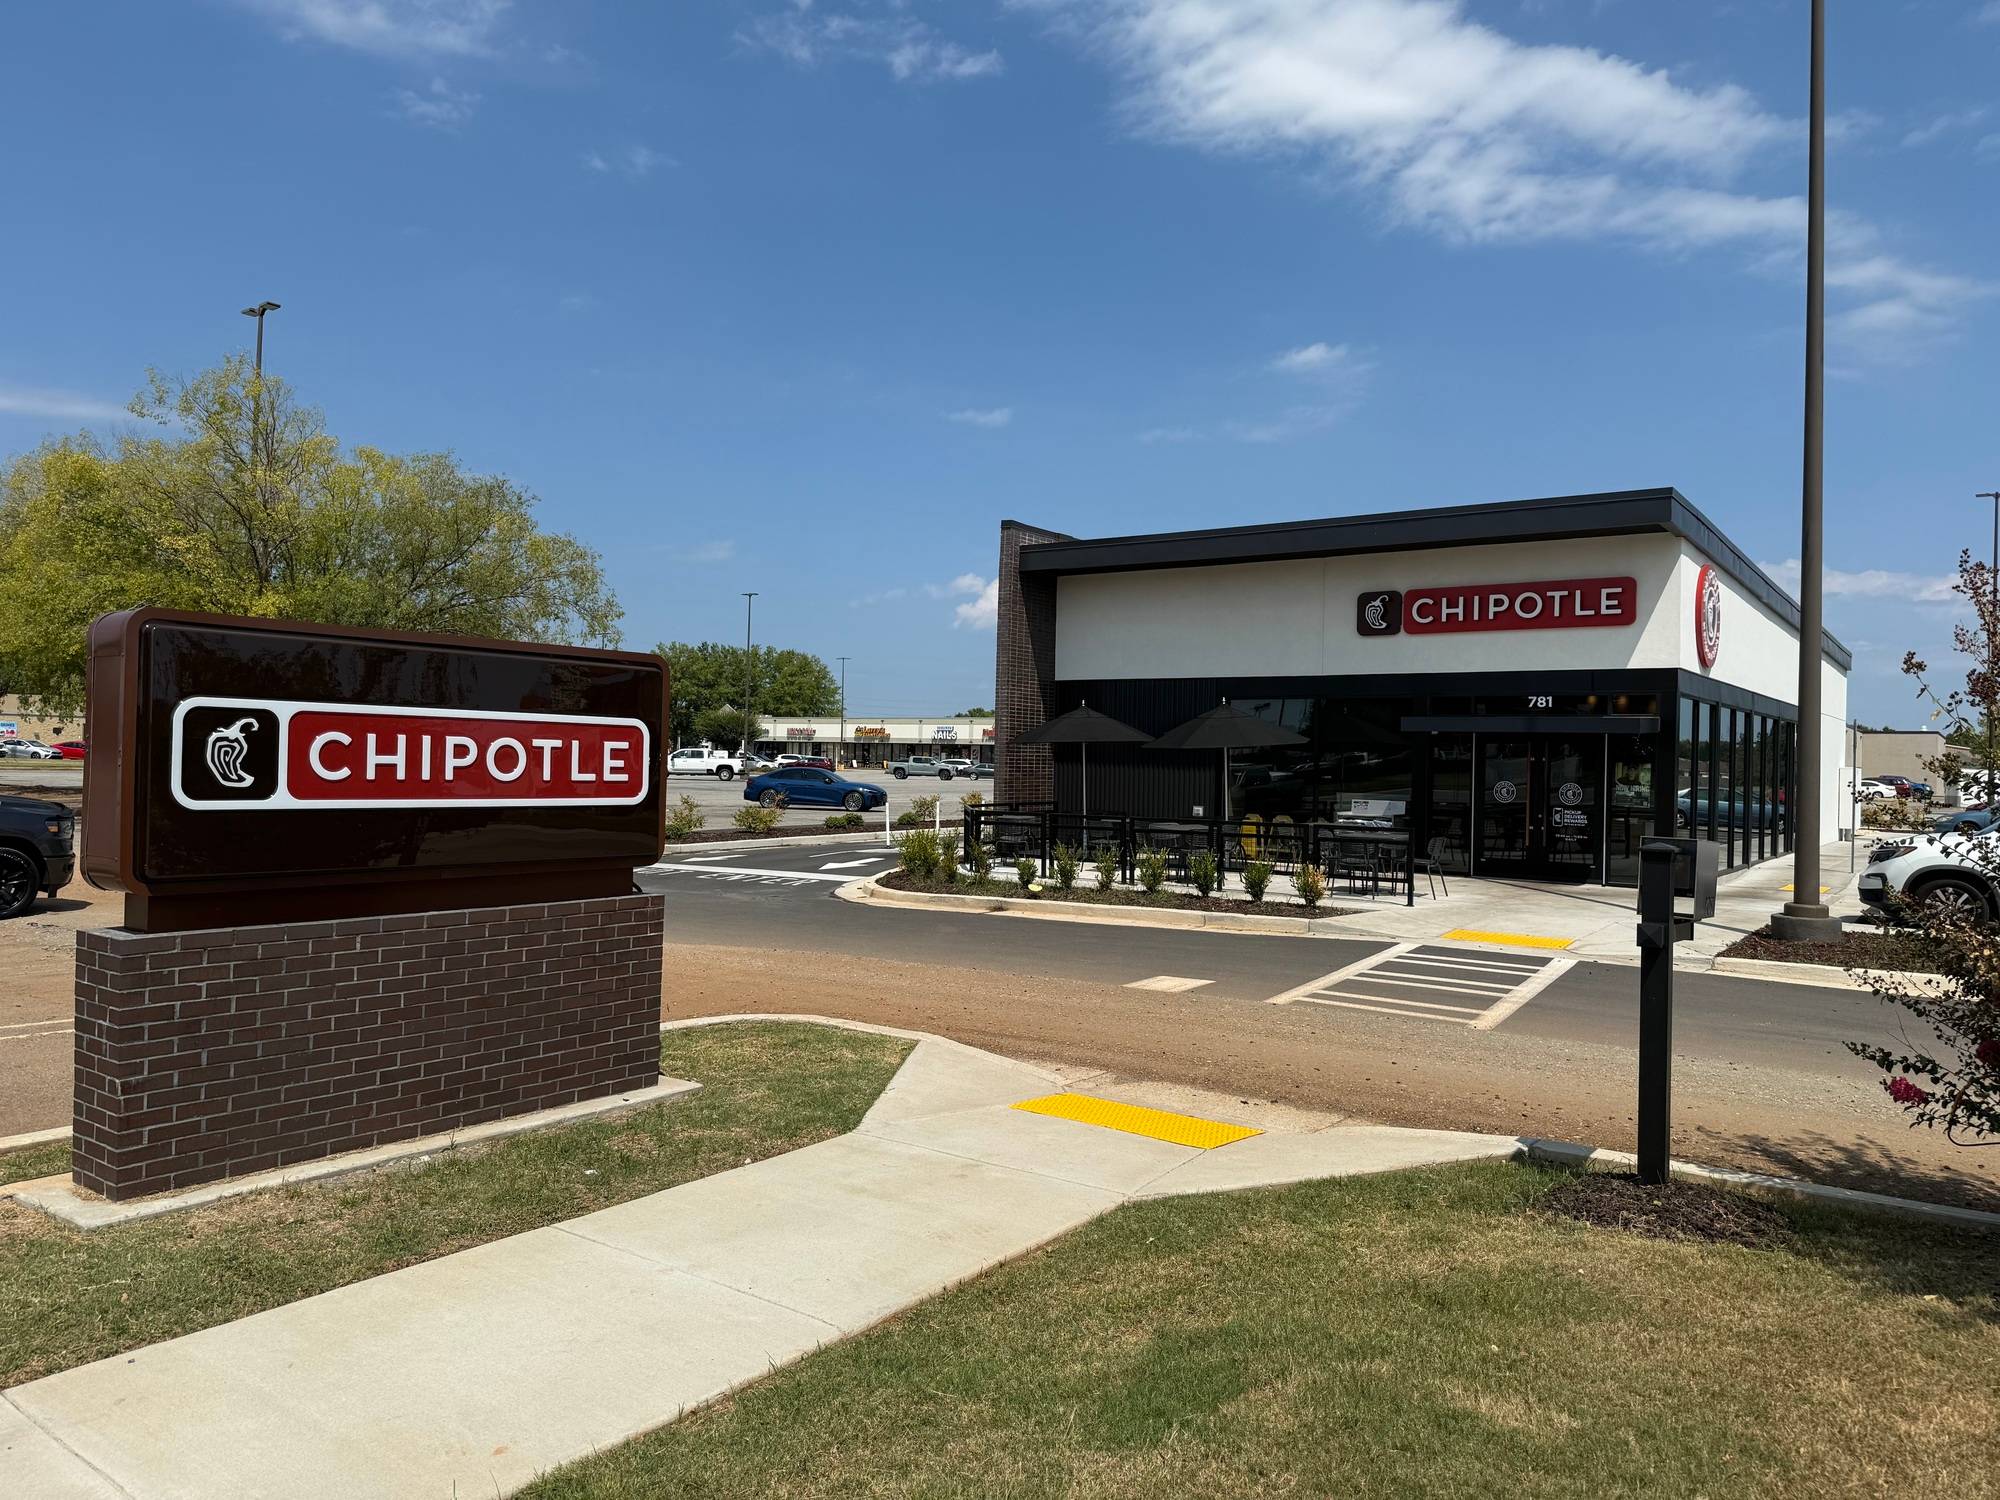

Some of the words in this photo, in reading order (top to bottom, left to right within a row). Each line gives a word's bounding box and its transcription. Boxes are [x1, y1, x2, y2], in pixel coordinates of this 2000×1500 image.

[1411, 587, 1623, 624] CHIPOTLE
[1528, 696, 1553, 708] 781
[931, 730, 957, 740] NAILS
[309, 731, 630, 783] CHIPOTLE
[696, 872, 820, 886] ENTER
